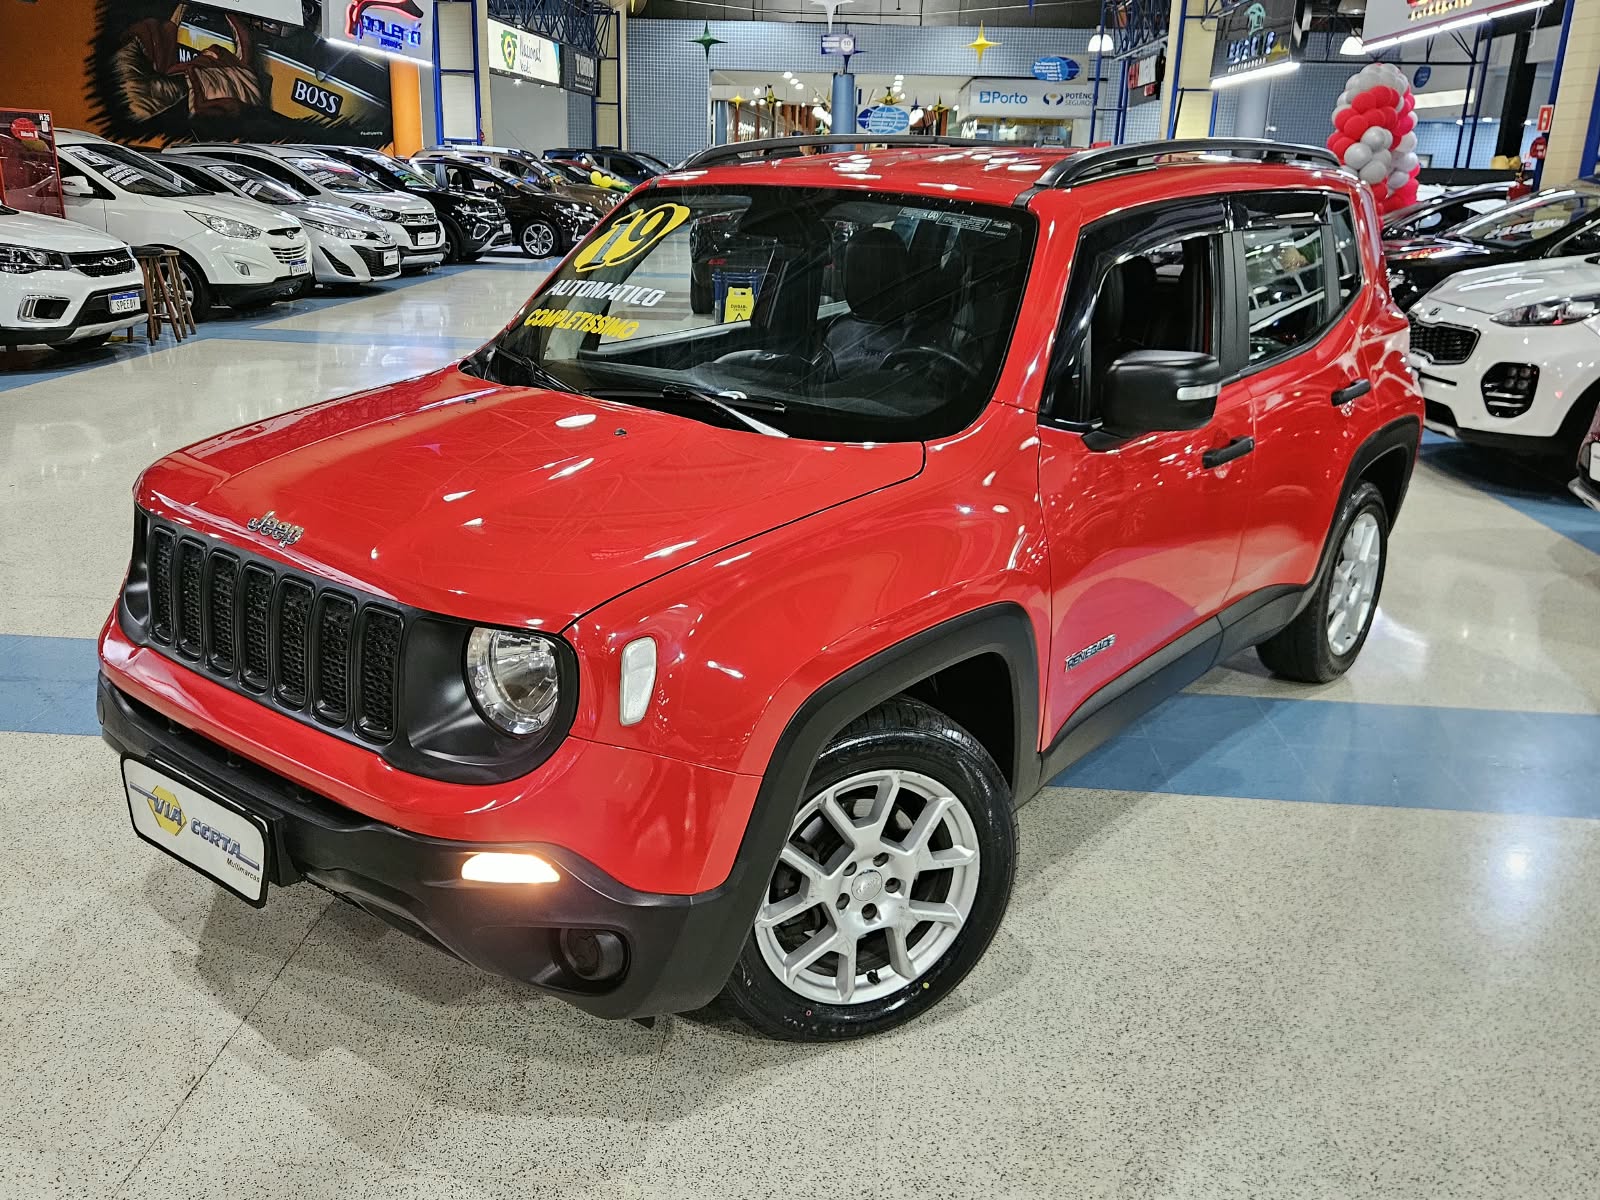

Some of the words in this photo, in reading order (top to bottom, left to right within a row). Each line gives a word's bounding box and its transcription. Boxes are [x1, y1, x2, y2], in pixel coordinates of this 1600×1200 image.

[294, 81, 340, 113] BOSS
[992, 91, 1028, 104] Porto
[574, 202, 690, 273] 19
[246, 510, 304, 549] Jeep
[152, 796, 183, 827] VIA
[190, 817, 242, 857] CERTA
[226, 857, 261, 884] Multimarcas
